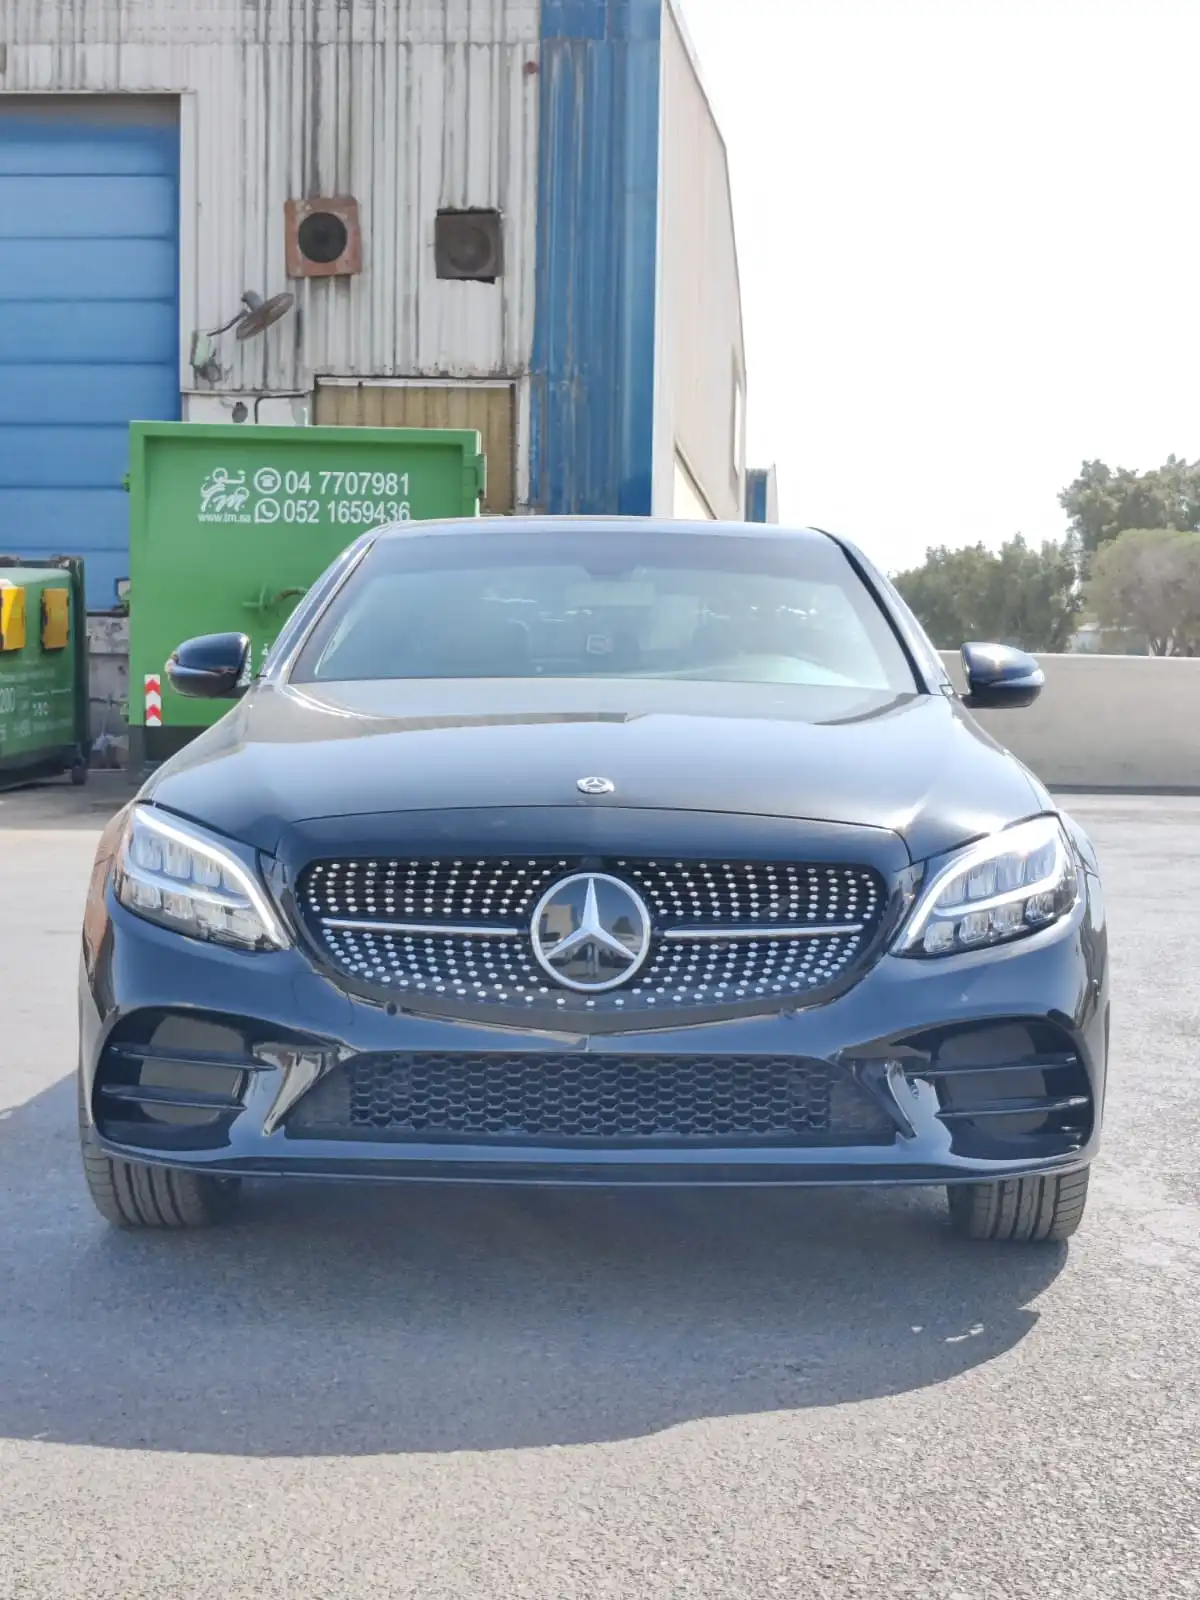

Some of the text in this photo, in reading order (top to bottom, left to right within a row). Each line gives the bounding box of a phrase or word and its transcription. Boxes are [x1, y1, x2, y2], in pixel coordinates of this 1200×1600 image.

[285, 470, 409, 496] 04 7707981
[283, 499, 410, 524] 052 1659436
